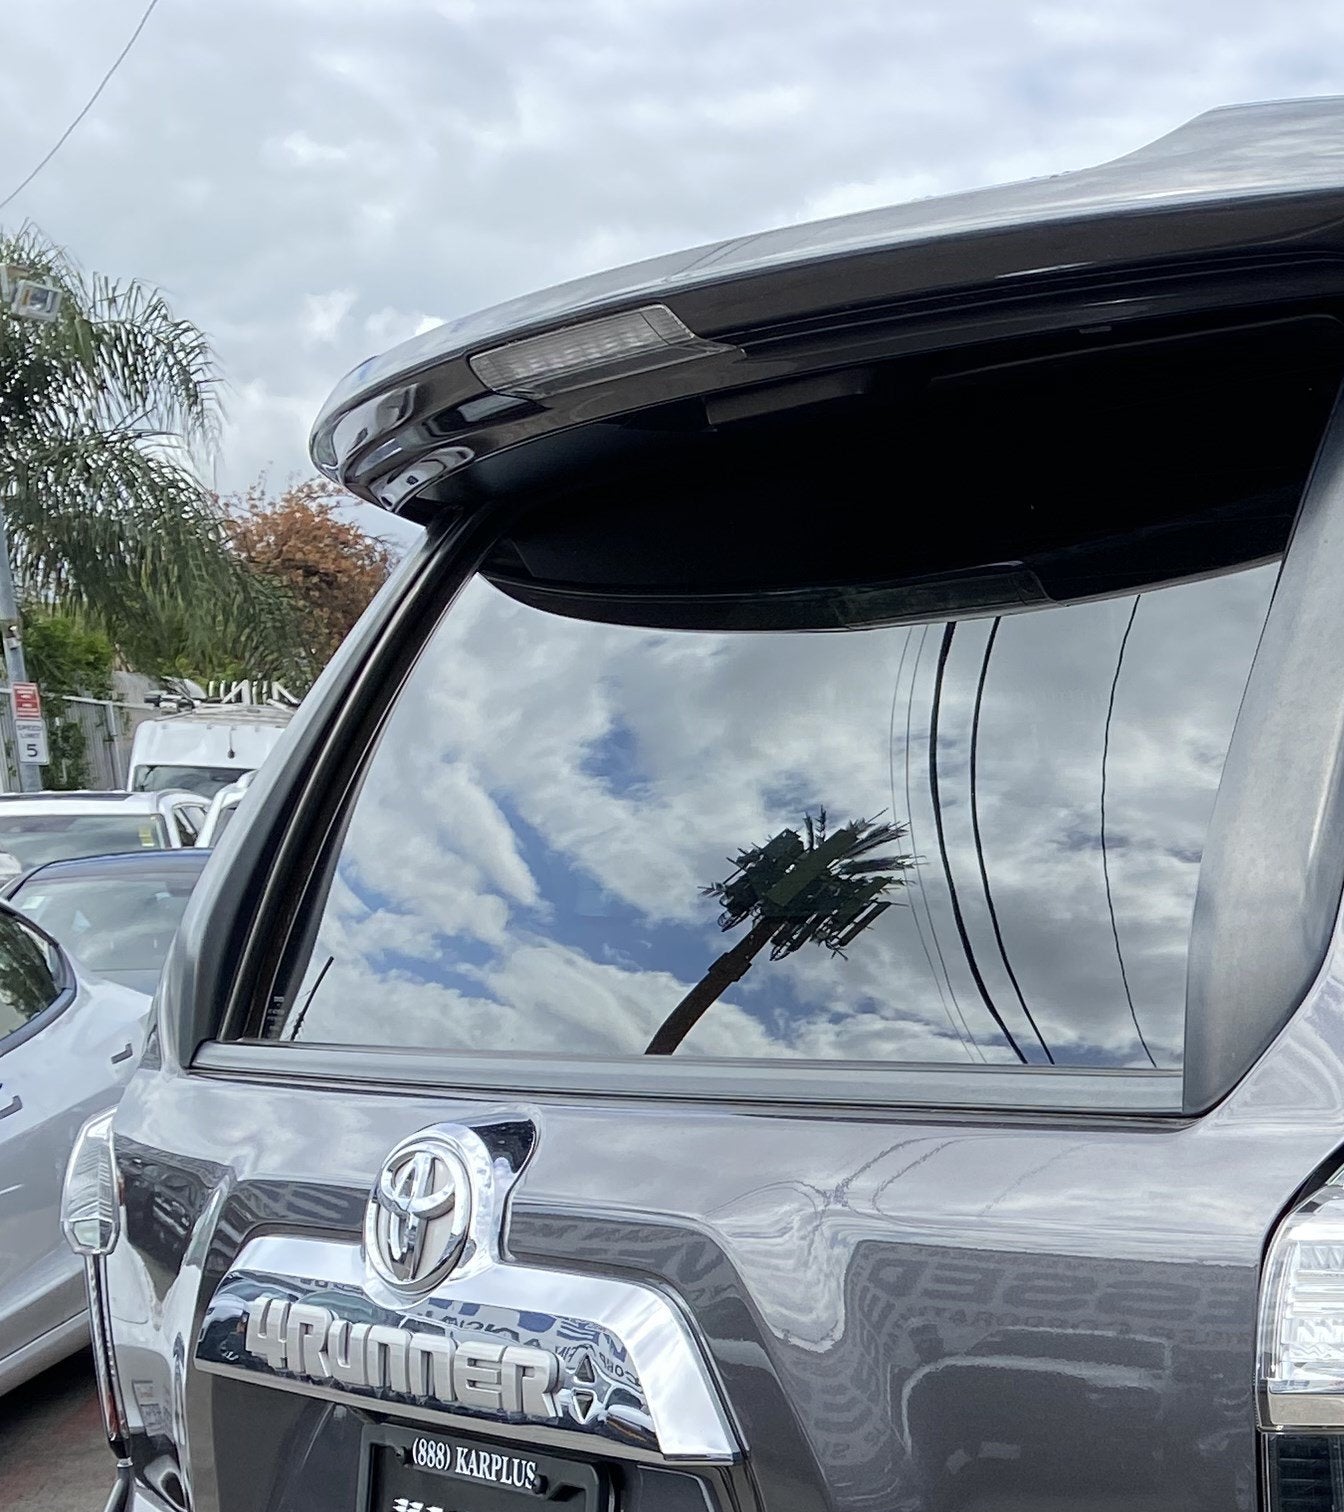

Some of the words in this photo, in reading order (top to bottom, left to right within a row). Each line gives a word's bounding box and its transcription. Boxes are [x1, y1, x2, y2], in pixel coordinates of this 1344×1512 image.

[26, 743, 38, 758] 5
[244, 1296, 568, 1418] 4RUNNER
[412, 1437, 452, 1472] (888)
[455, 1446, 538, 1490] KARPLUS
